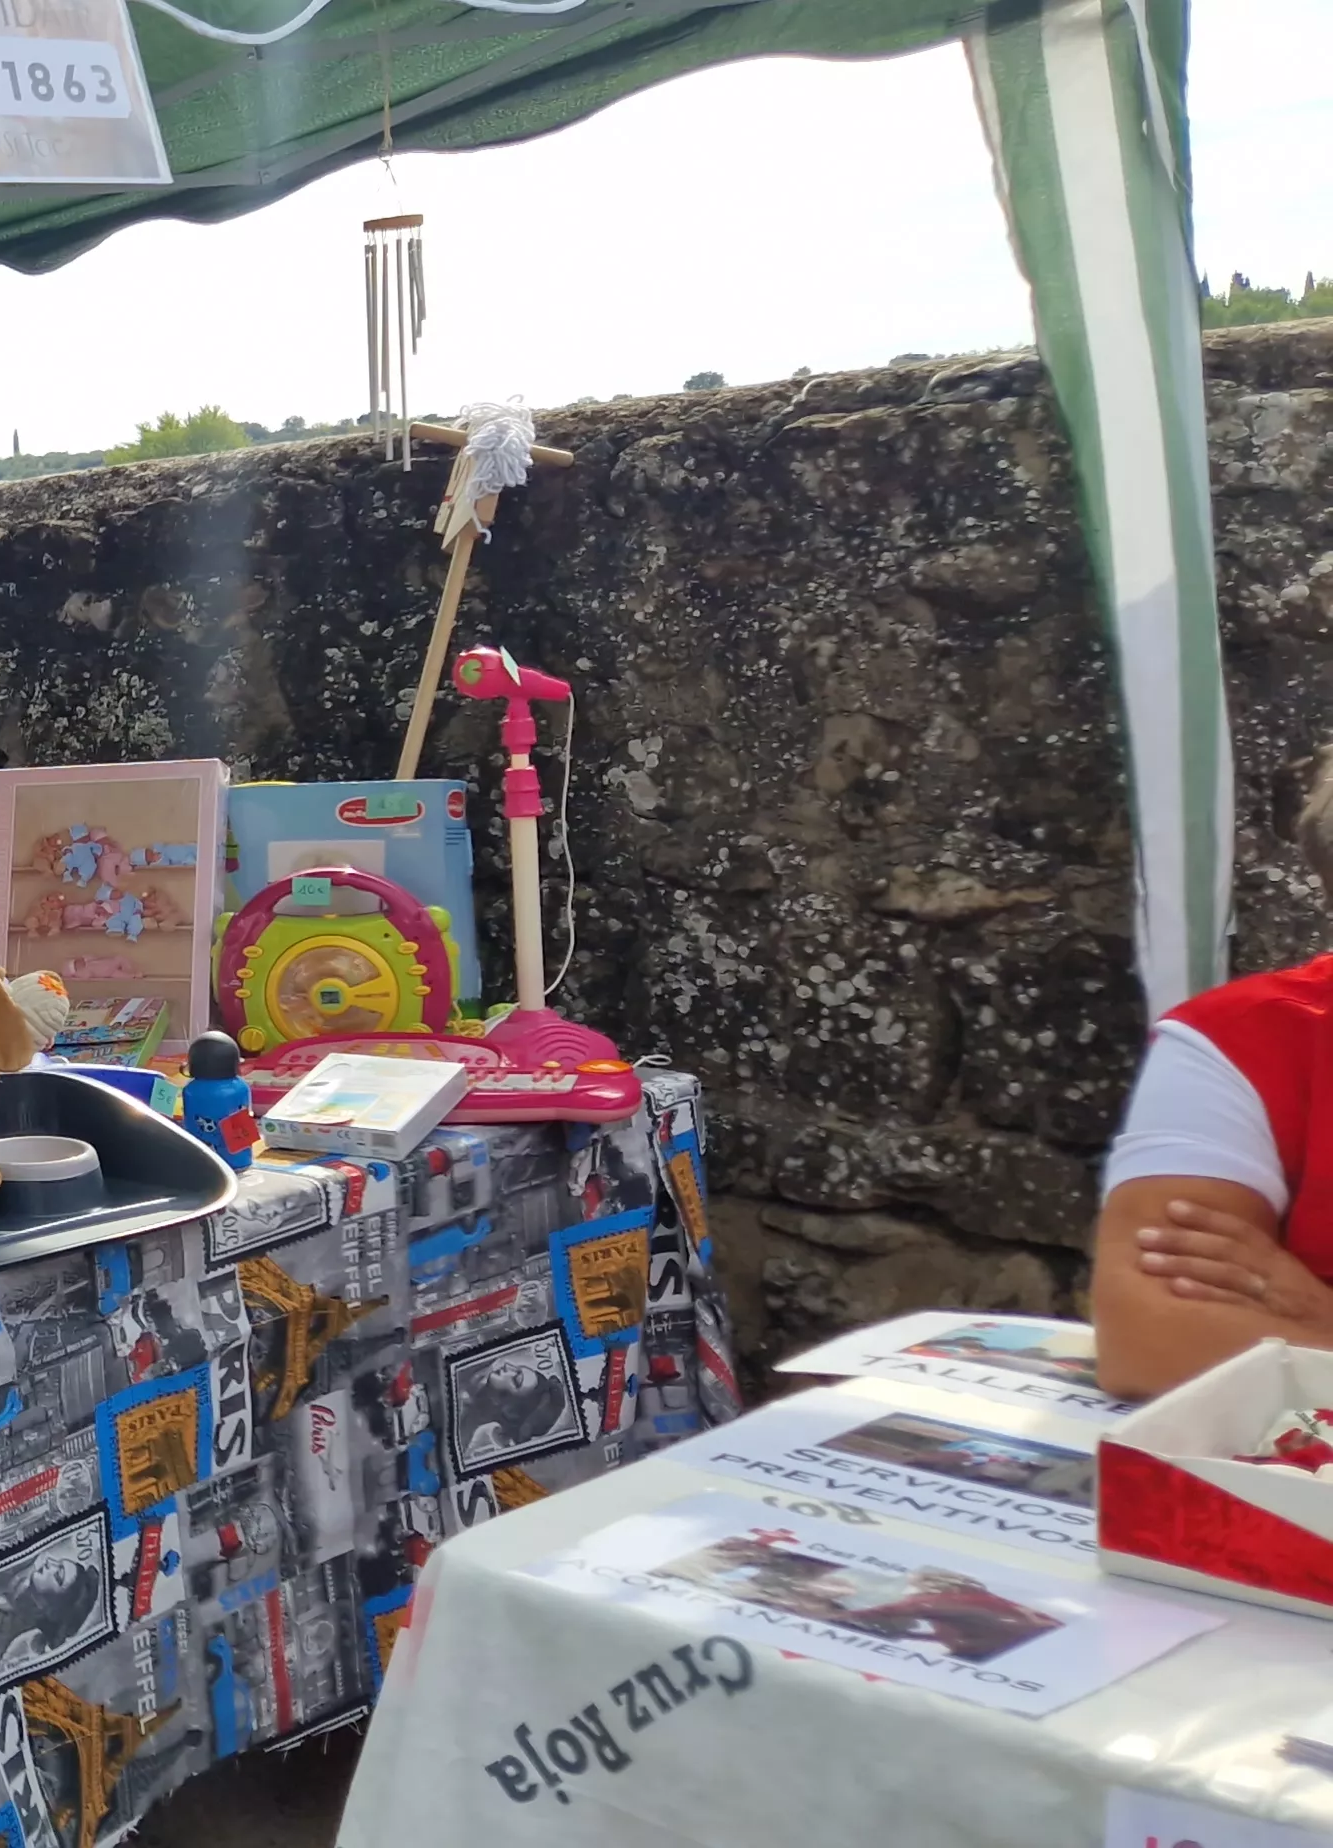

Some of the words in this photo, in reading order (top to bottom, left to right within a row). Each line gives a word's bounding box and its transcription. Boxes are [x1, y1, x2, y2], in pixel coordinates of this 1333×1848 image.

[308, 1404, 338, 1456] Paris
[859, 1353, 1135, 1416] TALLERE
[709, 1451, 1099, 1556] PREVENTIVOS
[783, 1446, 1097, 1529] SERVICIOS
[76, 1526, 99, 1561] 370
[133, 1629, 158, 1736] EIFFEL
[609, 1634, 756, 1734] Cruz
[483, 1702, 632, 1805] Roja
